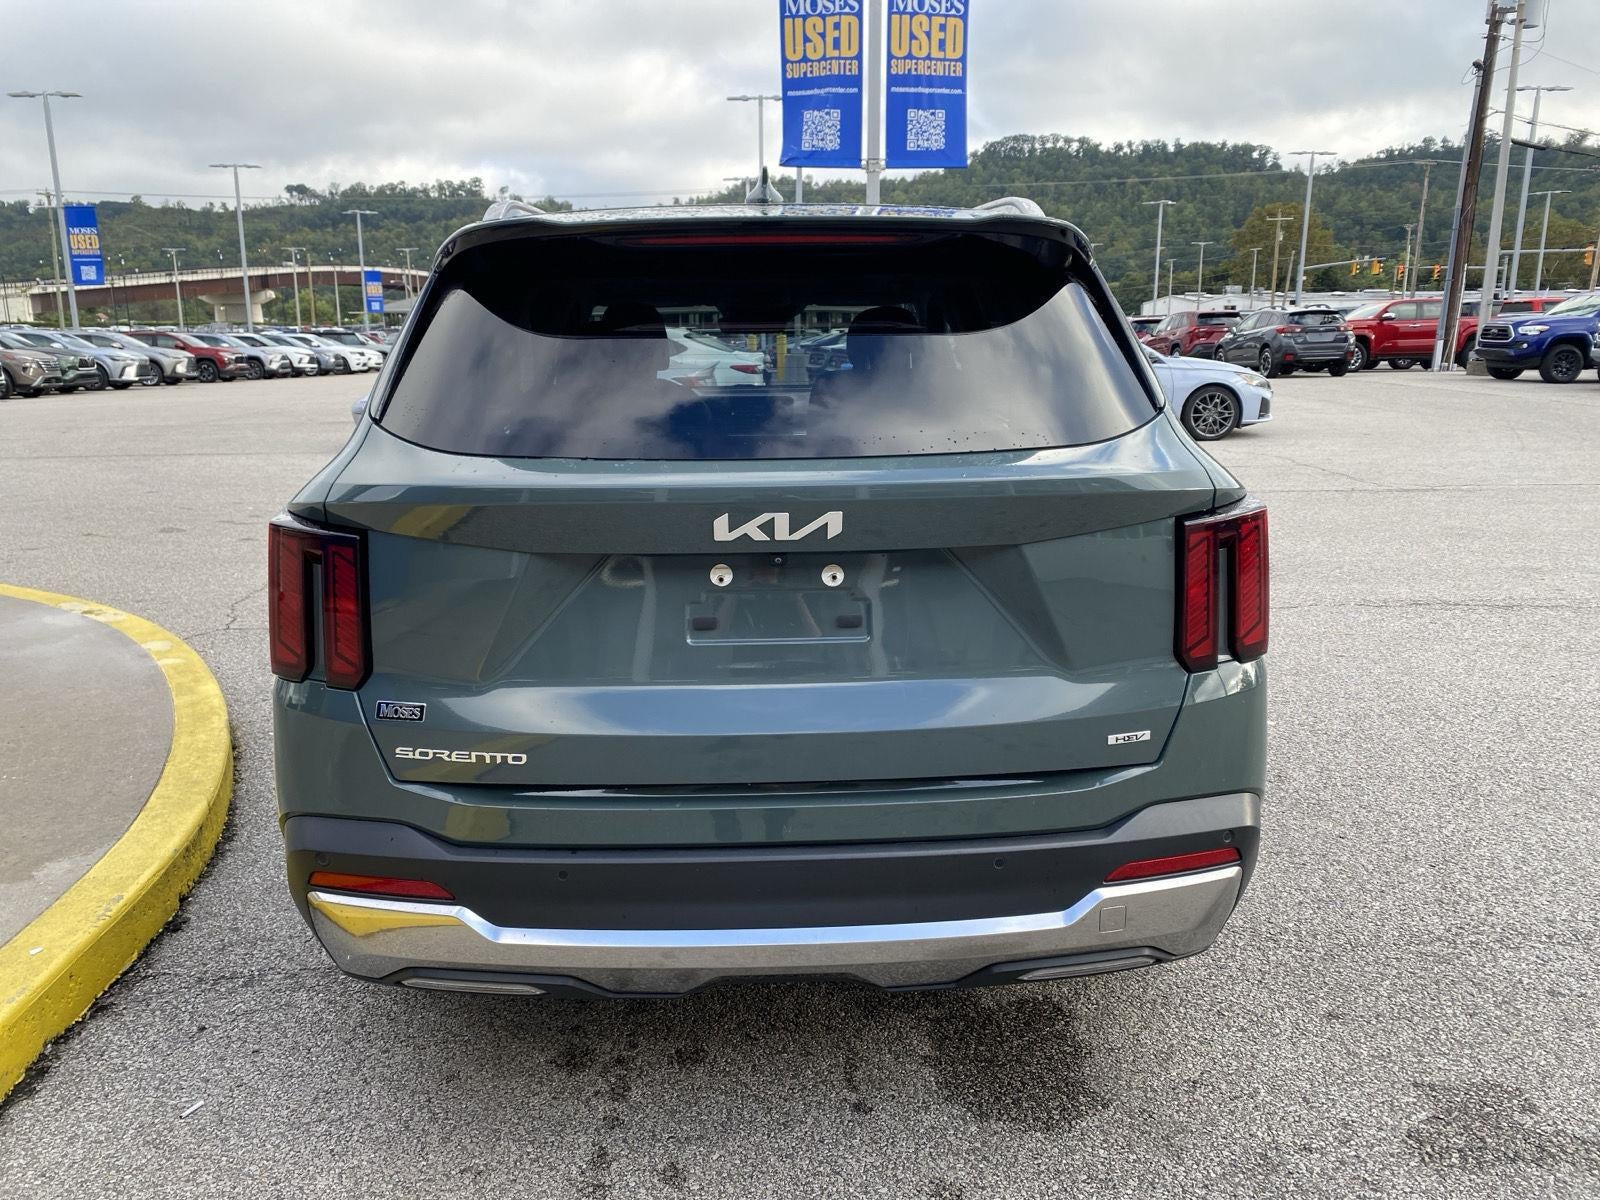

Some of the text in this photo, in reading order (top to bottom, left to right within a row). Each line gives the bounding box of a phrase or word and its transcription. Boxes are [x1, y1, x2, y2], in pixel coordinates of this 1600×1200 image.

[785, 0, 859, 15] MOSES
[892, 0, 965, 15] MOSES
[784, 15, 859, 61] USED
[891, 14, 964, 59] USED
[786, 60, 859, 79] SUPERCENTER
[890, 59, 963, 77] SUPERCENTER
[69, 226, 98, 235] MOSES
[70, 234, 100, 249] USED
[713, 511, 843, 541] KIA
[379, 703, 421, 719] MOSES
[1115, 732, 1146, 743] HEV
[395, 746, 527, 765] SORENTO
